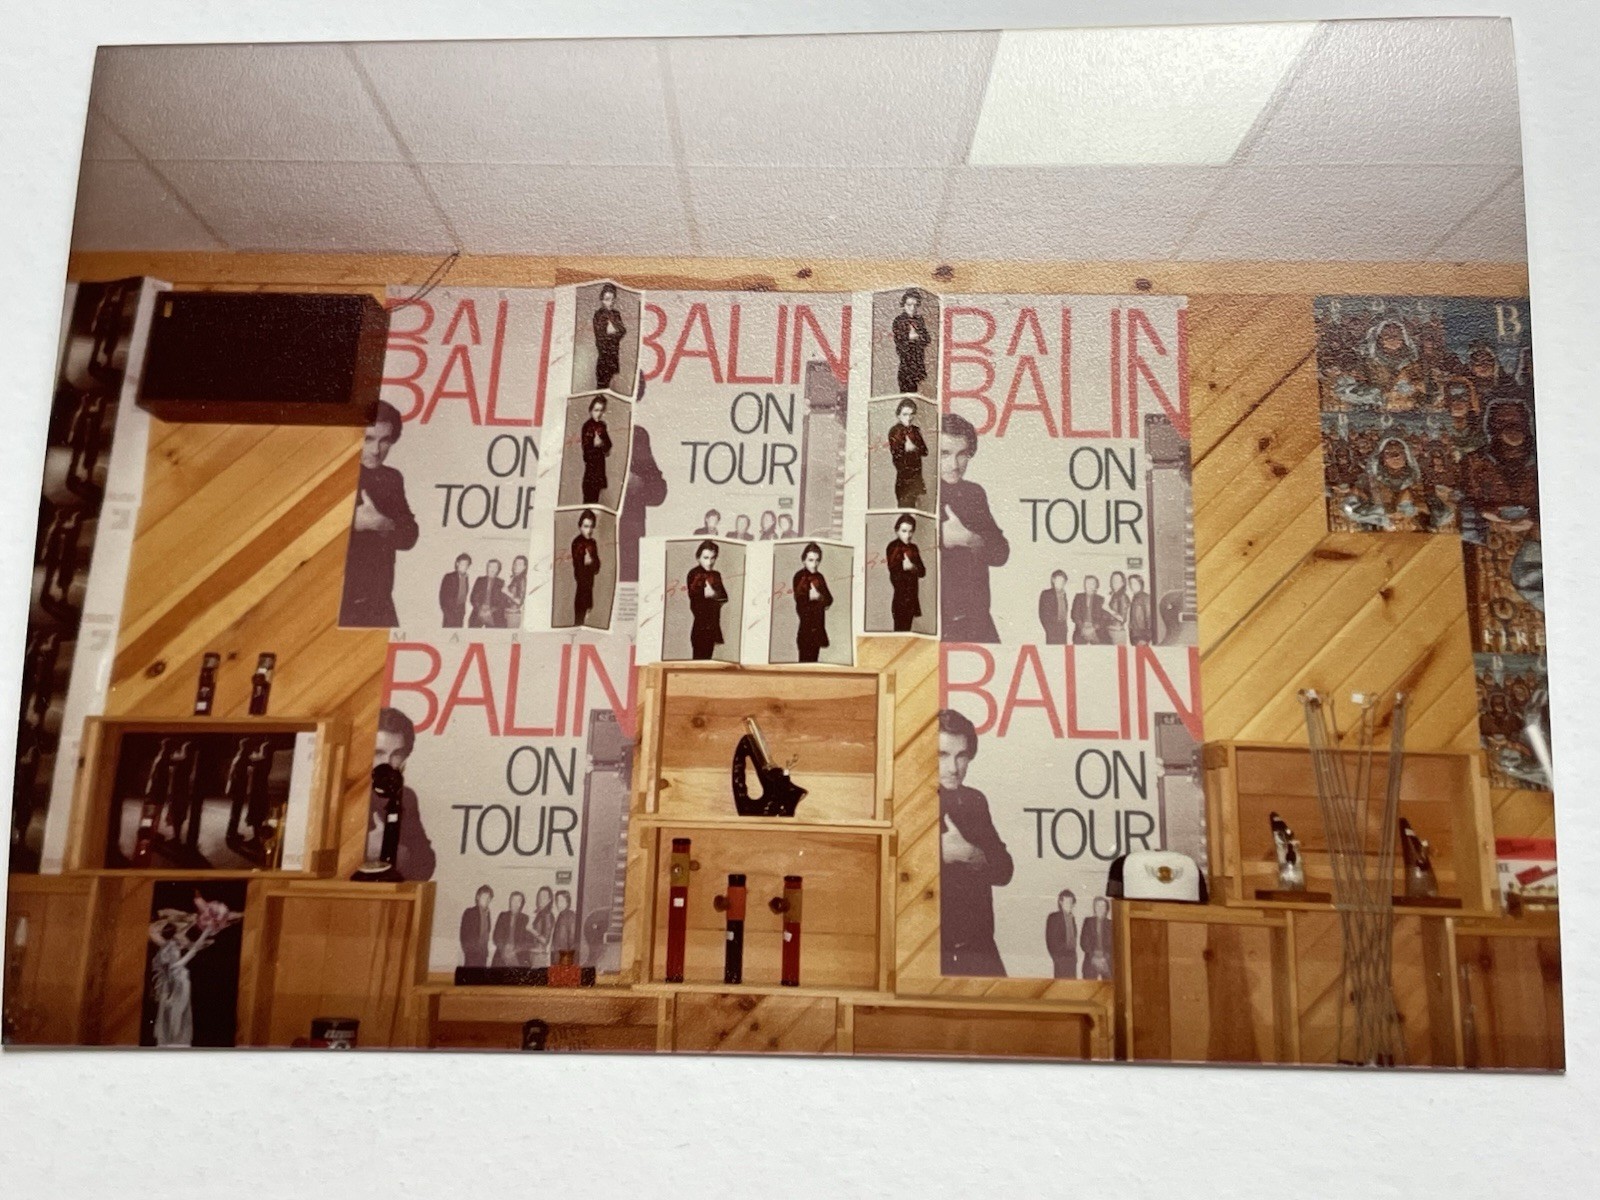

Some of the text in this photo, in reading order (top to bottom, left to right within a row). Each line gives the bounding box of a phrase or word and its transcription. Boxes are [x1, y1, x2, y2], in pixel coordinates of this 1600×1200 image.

[643, 302, 853, 384] BALIN
[730, 391, 795, 435] ON
[942, 354, 1191, 440] BALIN
[681, 441, 798, 485] TOUR
[1069, 446, 1136, 491] ON
[1020, 498, 1143, 545] TOUR
[380, 641, 638, 741] BALIN
[938, 641, 1204, 742] BALIN
[506, 745, 577, 796] ON
[1075, 748, 1147, 800] ON
[452, 804, 579, 857] TOUR
[1023, 807, 1155, 862] TOUR
